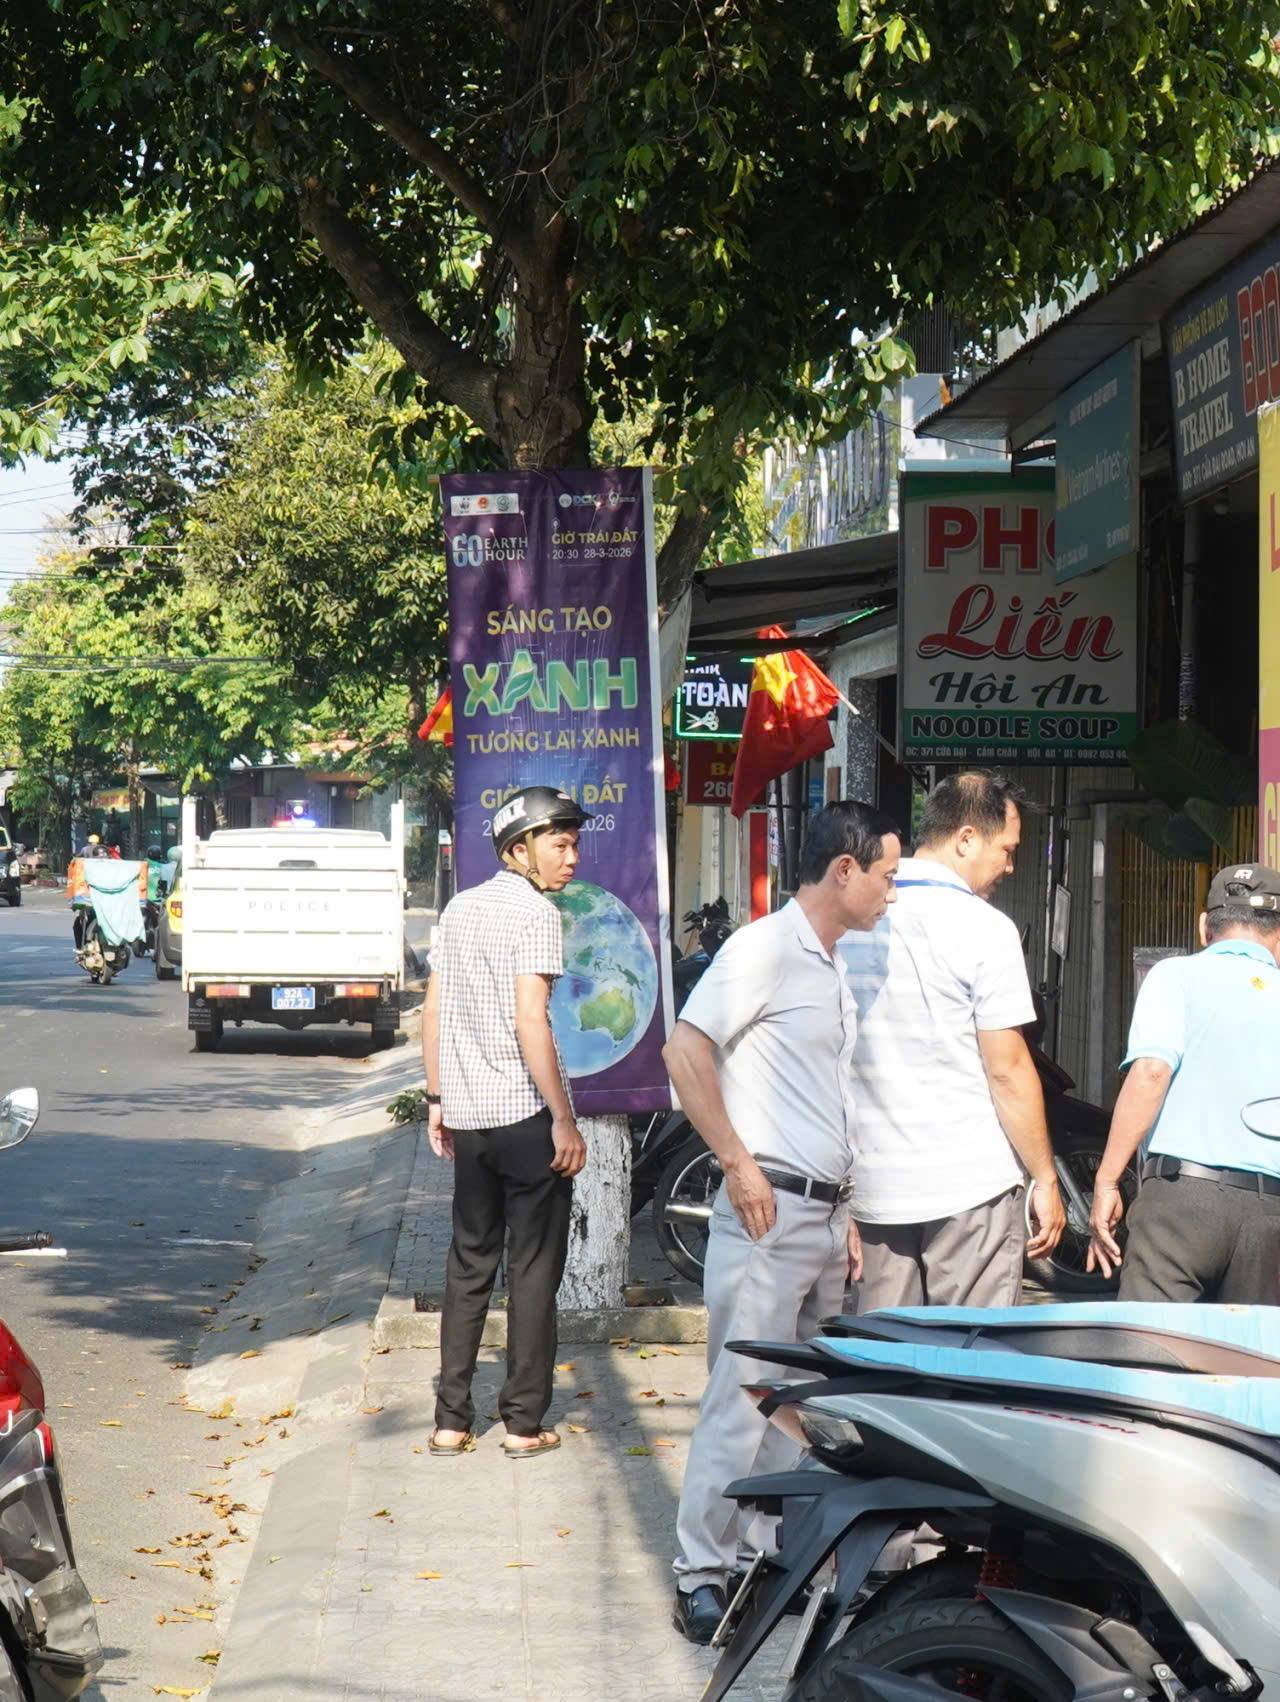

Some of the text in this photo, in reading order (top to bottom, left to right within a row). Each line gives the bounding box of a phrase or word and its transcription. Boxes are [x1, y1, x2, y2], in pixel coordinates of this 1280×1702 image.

[1175, 368, 1185, 408] B
[1187, 337, 1231, 401] HOME
[1179, 392, 1233, 456] TRAVEL
[485, 536, 529, 550] EARTH
[551, 526, 639, 545] GIỜ TRÁI ĐẤT
[924, 503, 1056, 575] PH
[485, 549, 526, 561] HOUR
[551, 547, 632, 560] 20:30 28-3-2026
[487, 604, 613, 638] SÁNG TẠO
[462, 648, 638, 717] XANH
[928, 671, 1111, 710] Hội An
[467, 728, 640, 753] TƯƠNG LAI XANH
[911, 715, 1120, 741] NOODLE SOUP
[583, 775, 628, 804] ĐẤT
[248, 900, 330, 913] POLICE
